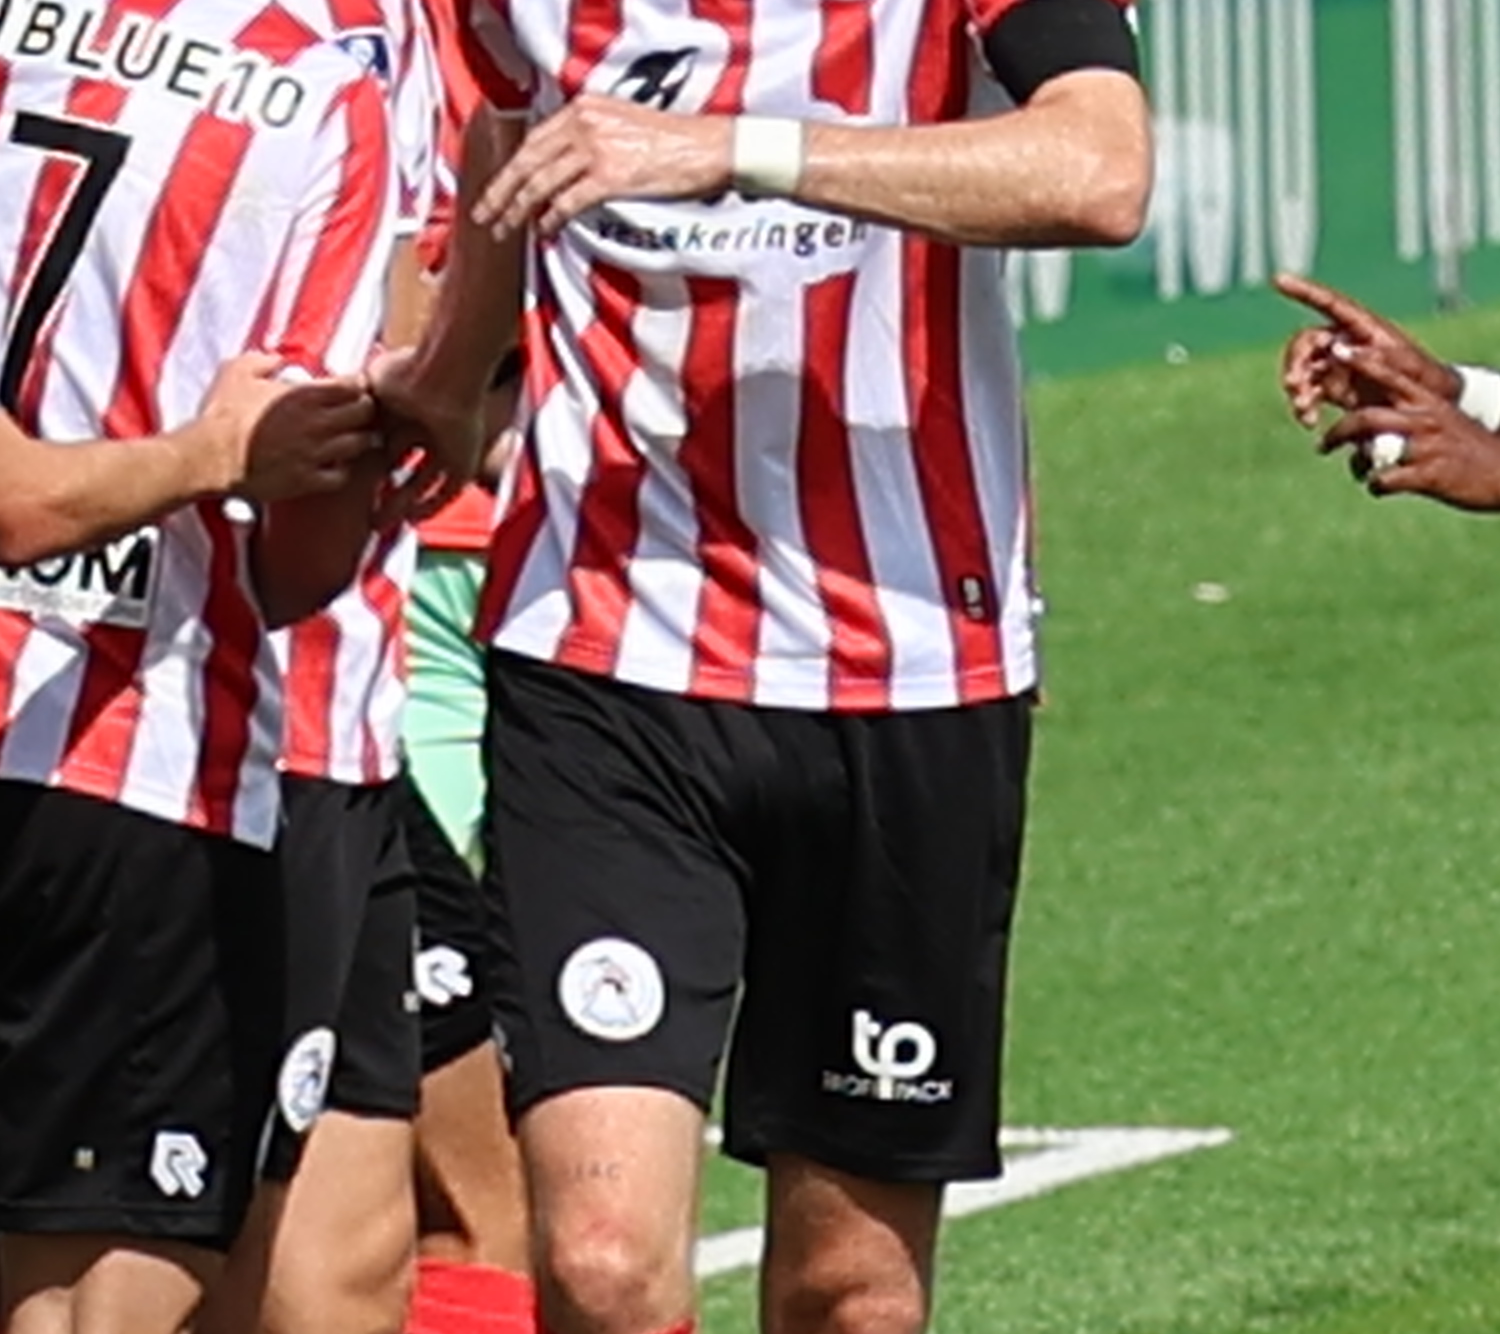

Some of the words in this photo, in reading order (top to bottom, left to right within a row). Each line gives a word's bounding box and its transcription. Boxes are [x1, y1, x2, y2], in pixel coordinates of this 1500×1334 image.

[15, 0, 306, 129] BLUE10
[0, 110, 134, 425] 7
[598, 213, 870, 259] veekeringen
